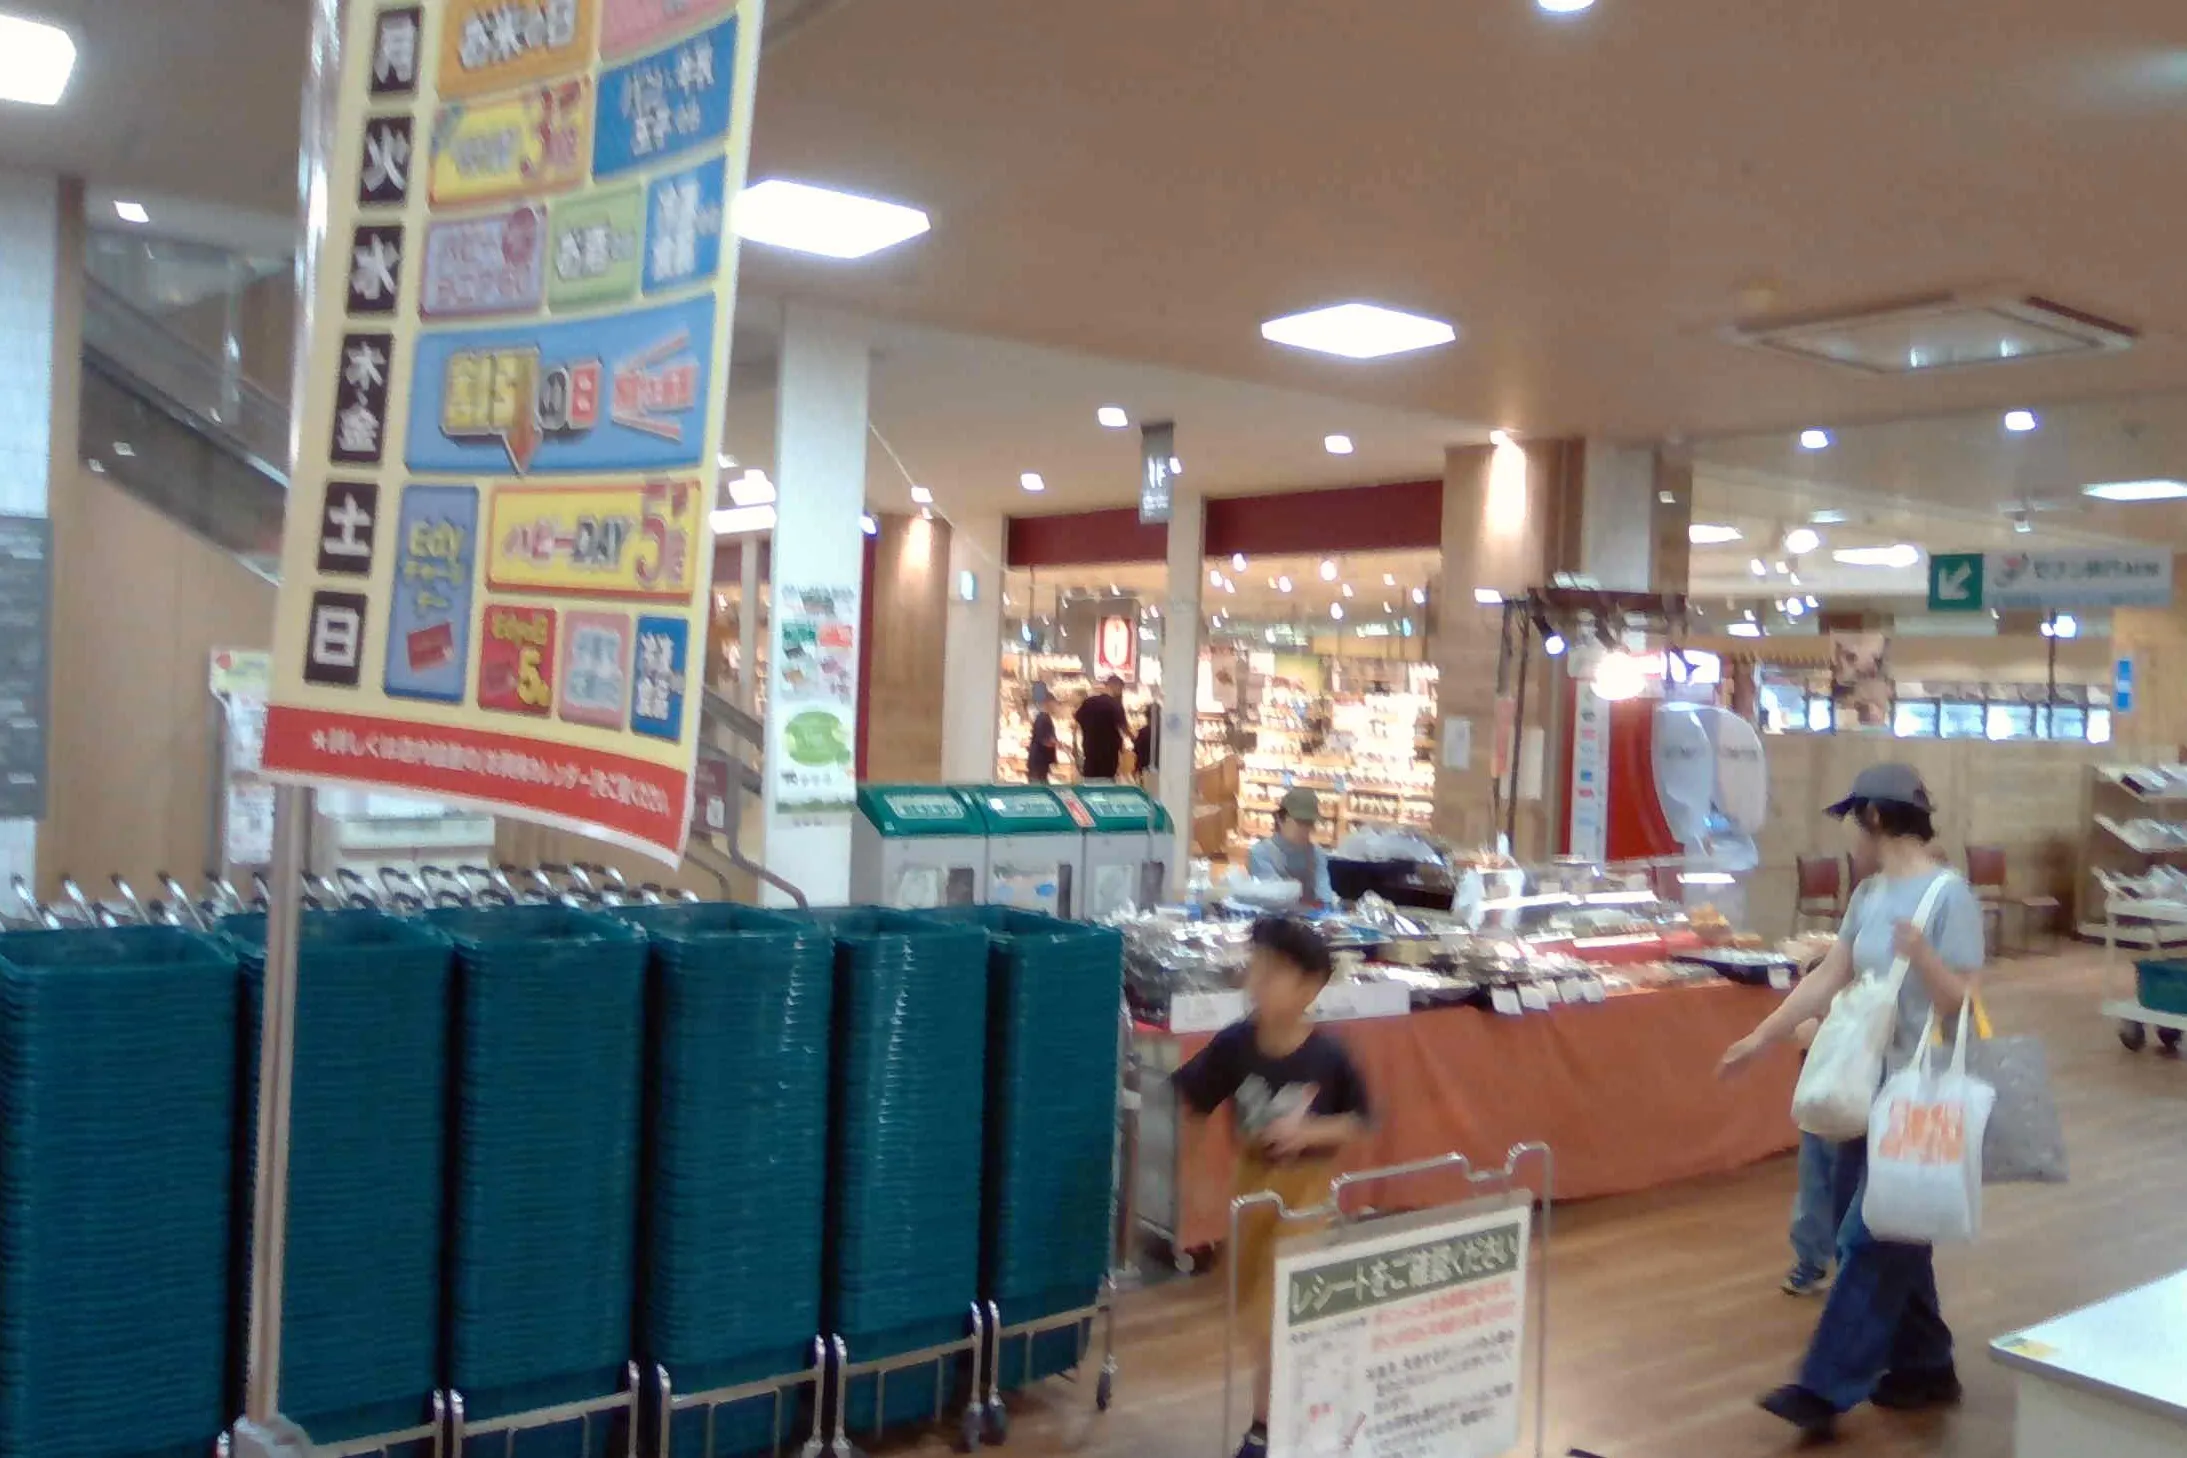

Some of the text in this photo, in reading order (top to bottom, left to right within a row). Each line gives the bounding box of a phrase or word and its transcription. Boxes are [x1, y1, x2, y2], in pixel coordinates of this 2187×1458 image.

[374, 13, 415, 84] 月
[361, 124, 411, 192] 火
[351, 232, 400, 301] 水
[323, 491, 371, 556] 土
[312, 603, 360, 667] 日
[1289, 1232, 1518, 1318] レシートをご確認ください
